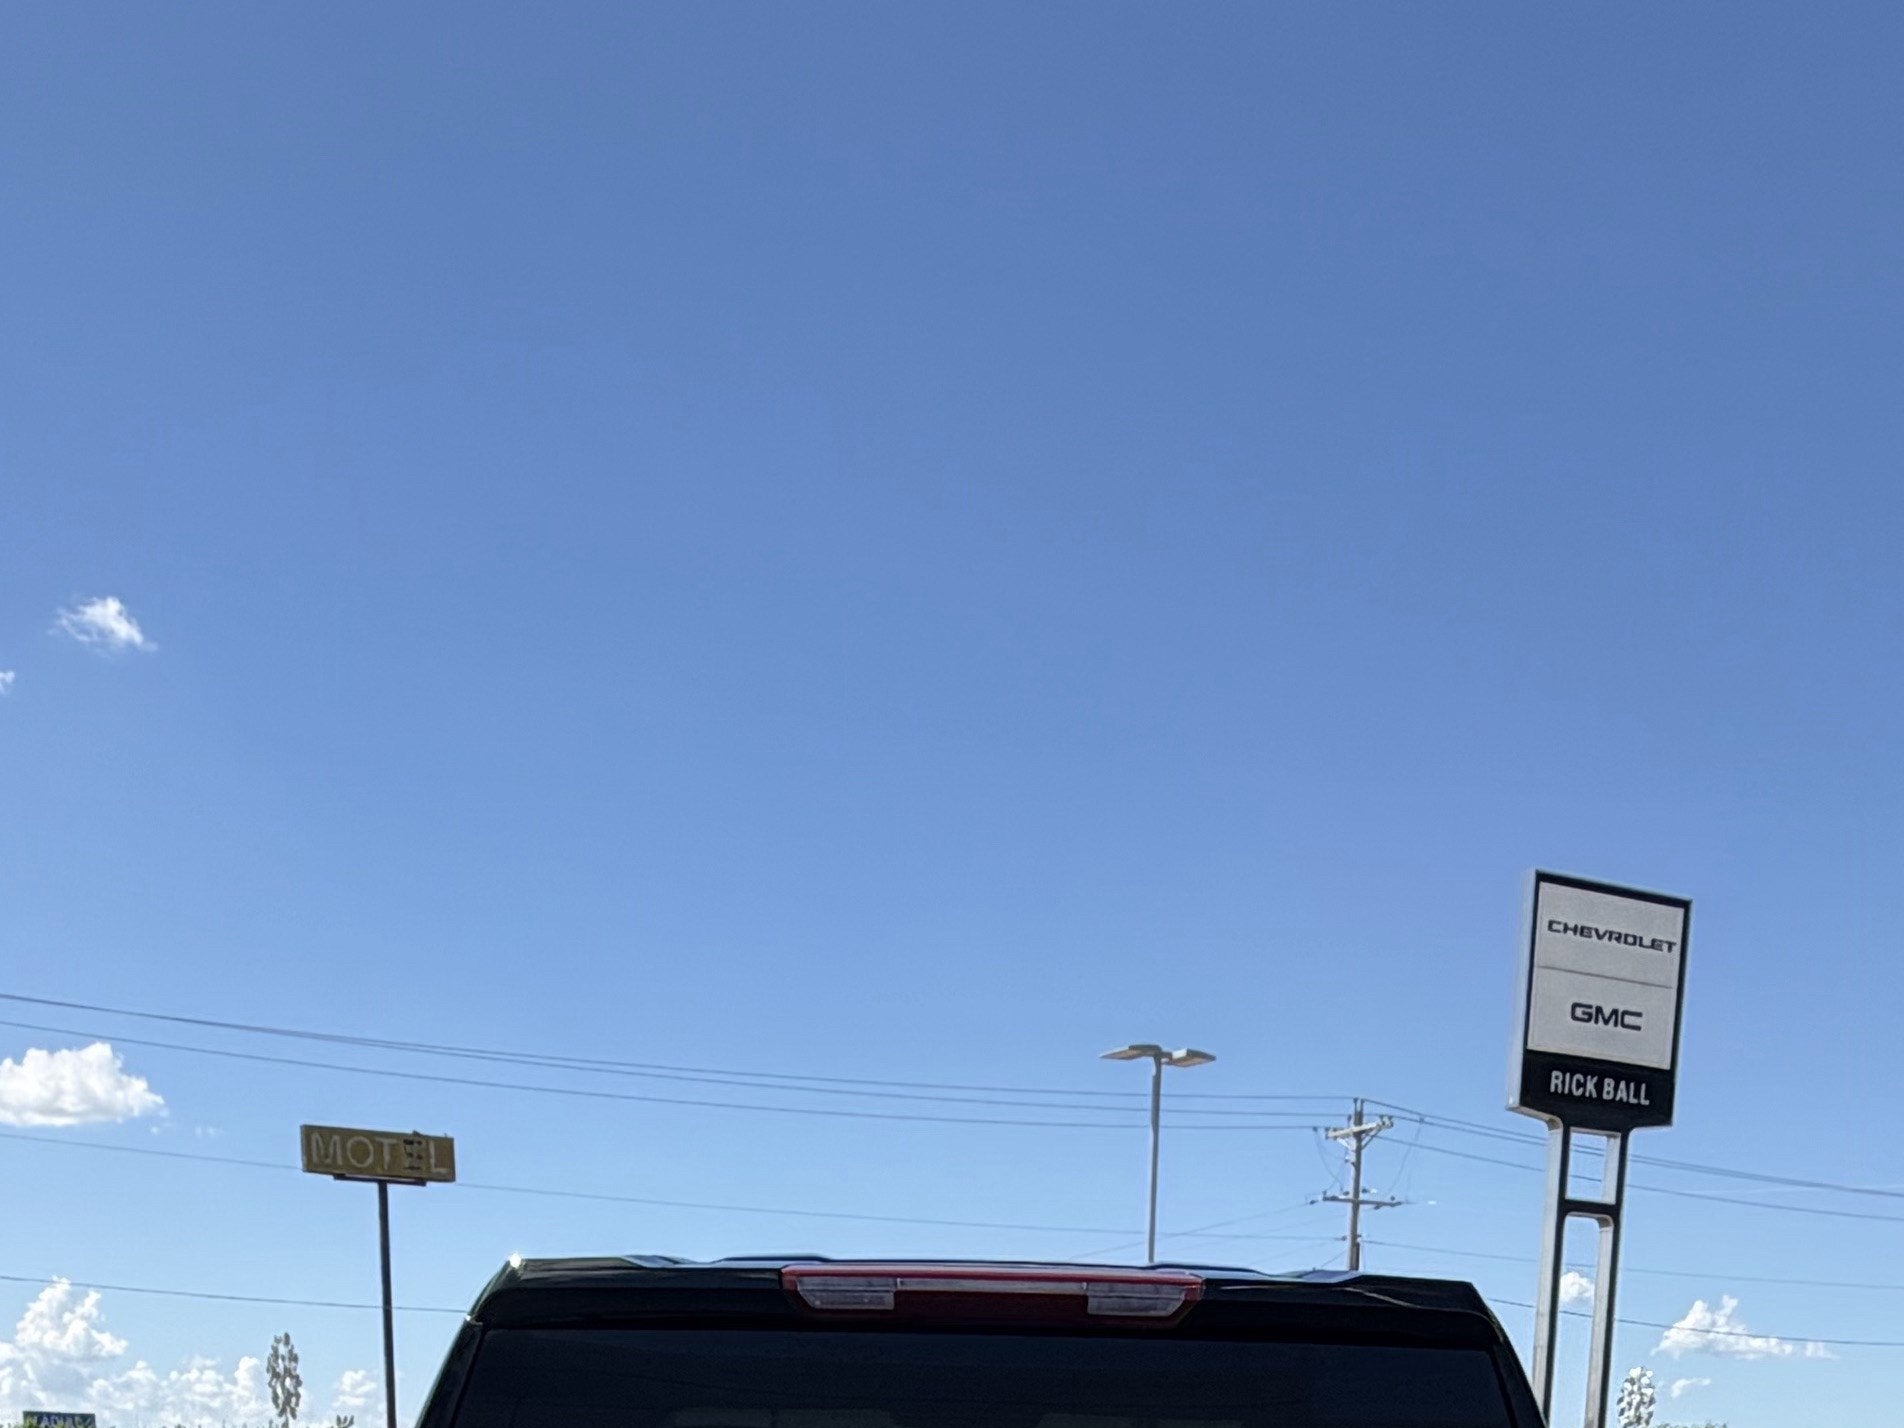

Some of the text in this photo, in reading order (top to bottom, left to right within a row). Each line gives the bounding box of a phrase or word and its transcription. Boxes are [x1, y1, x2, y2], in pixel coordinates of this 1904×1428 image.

[1547, 919, 1676, 953] CHEVROLET
[1570, 1002, 1643, 1031] GMC
[1549, 1070, 1650, 1106] RICK BALL
